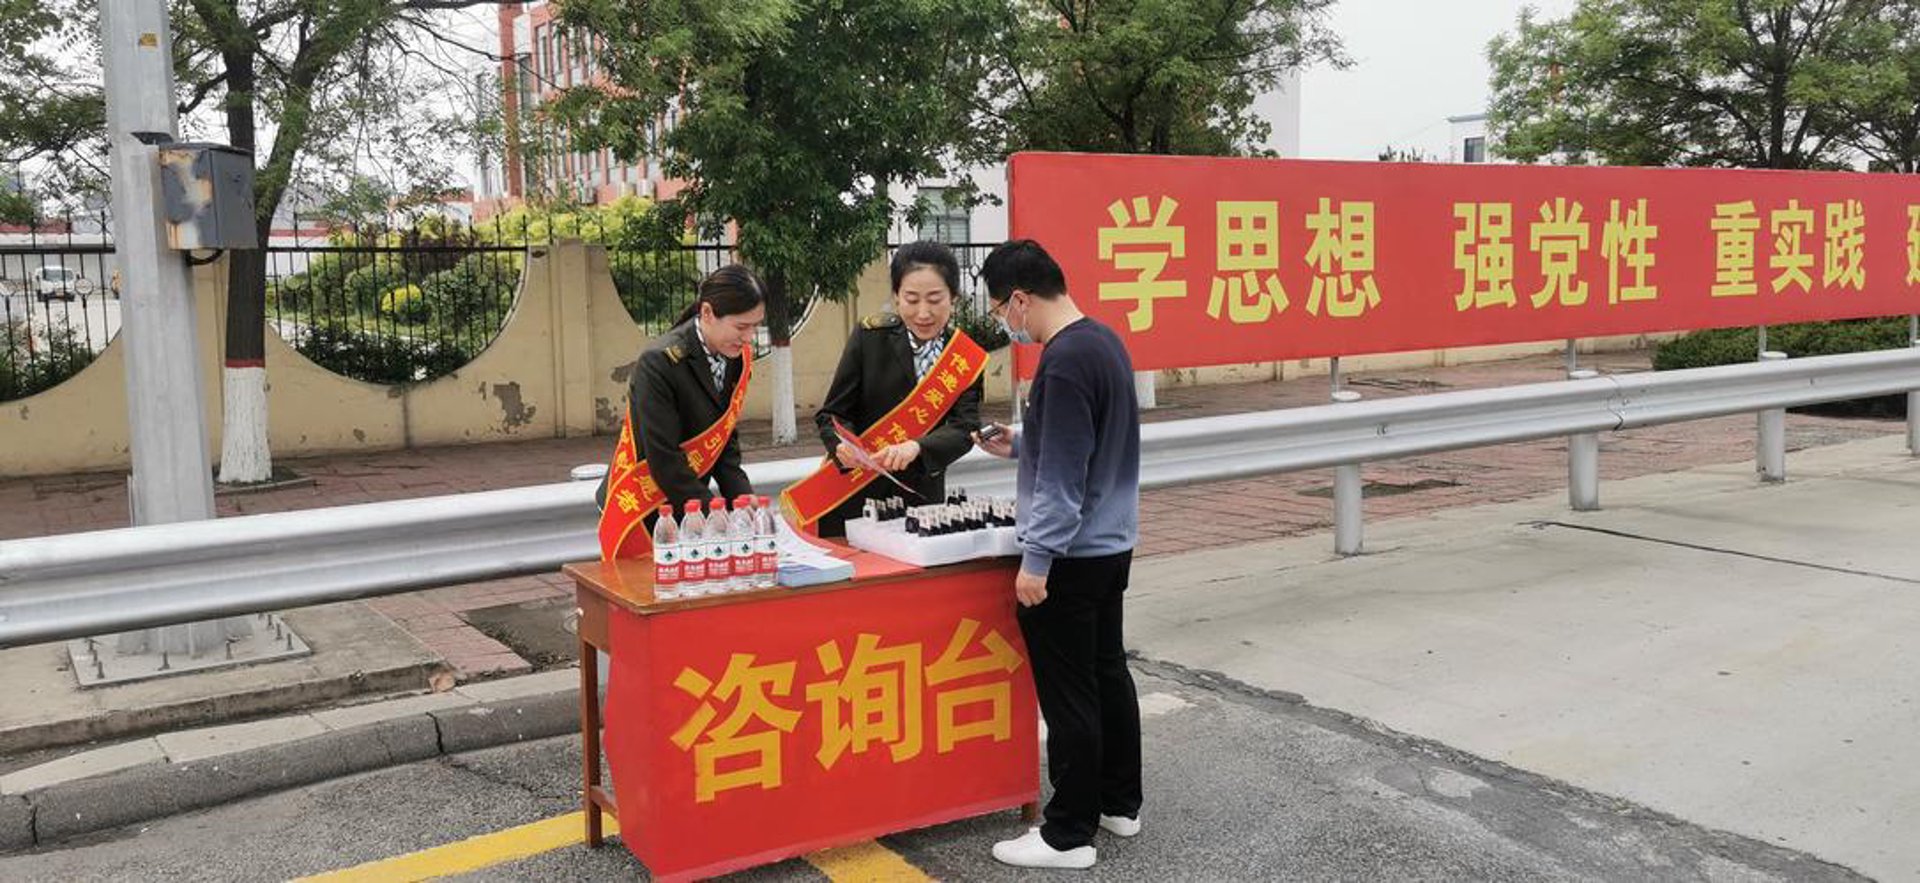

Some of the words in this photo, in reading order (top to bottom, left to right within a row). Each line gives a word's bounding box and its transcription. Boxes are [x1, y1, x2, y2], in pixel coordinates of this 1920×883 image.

[1097, 196, 1381, 332] 学思想
[1454, 197, 1658, 311] 强党性
[1711, 200, 1867, 296] 重实践
[670, 618, 1024, 803] 咨询台
